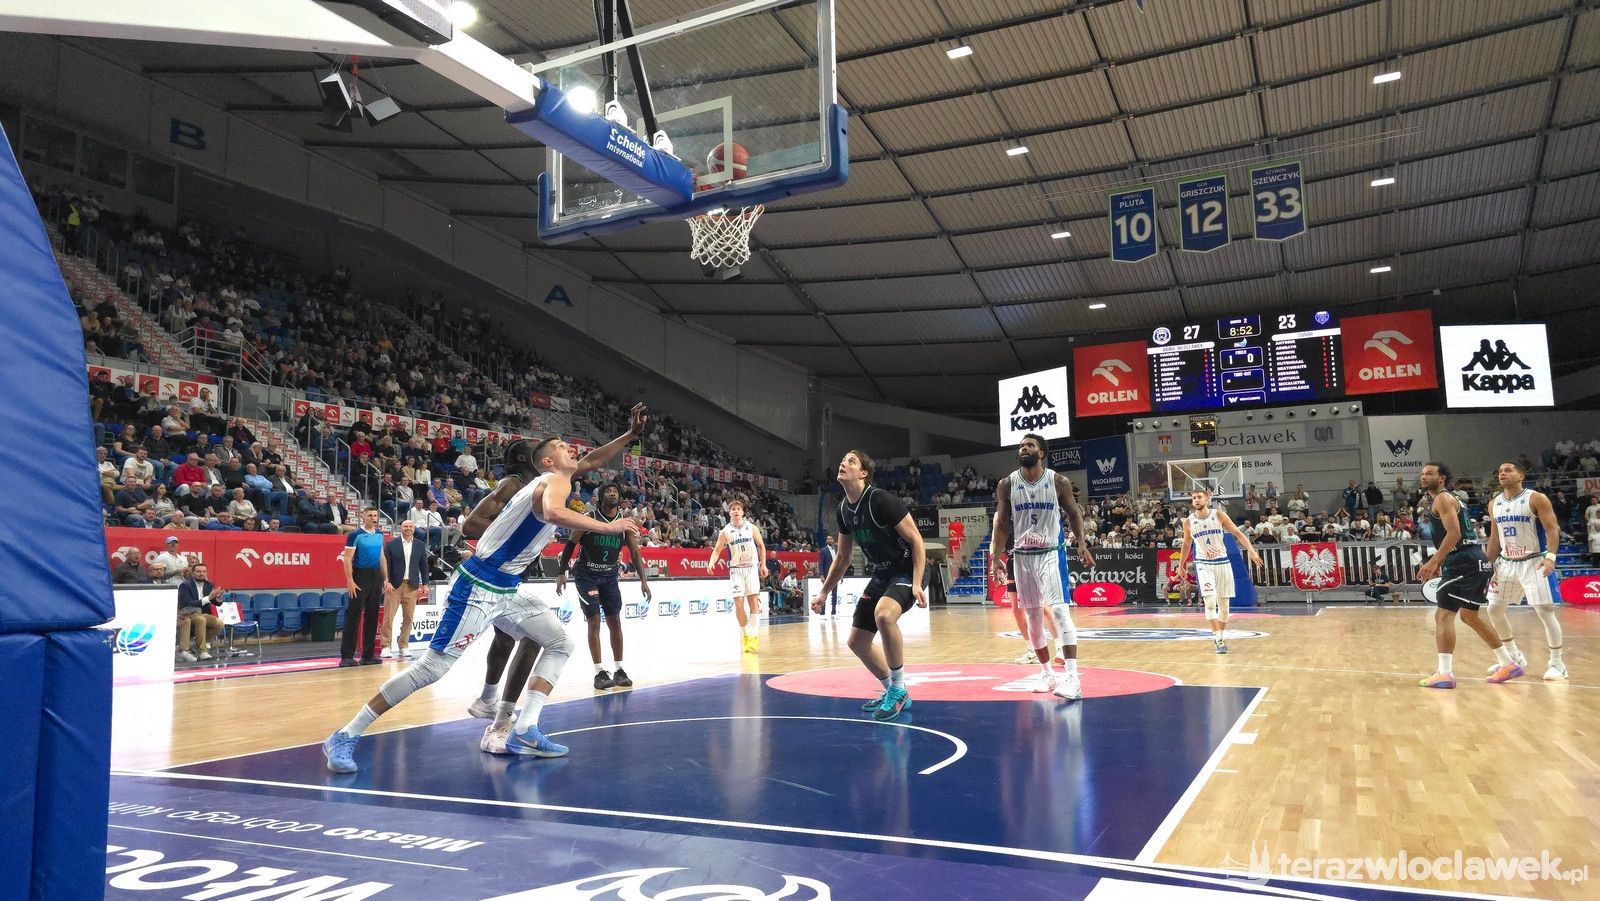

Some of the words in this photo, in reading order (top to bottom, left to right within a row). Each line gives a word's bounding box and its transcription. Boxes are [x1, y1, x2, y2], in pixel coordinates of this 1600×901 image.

[170, 118, 206, 150] B
[1253, 171, 1300, 185] SZEWCZYK
[1180, 184, 1225, 198] GRISZCZUK
[1119, 199, 1145, 208] PLUTA
[1256, 187, 1301, 222] 33
[1185, 200, 1223, 235] 12
[1114, 212, 1152, 245] 10
[543, 285, 574, 307] A
[1278, 314, 1296, 329] 23
[1183, 325, 1200, 340] 27
[1229, 325, 1253, 337] 8:52
[1228, 355, 1233, 364] 1
[1247, 353, 1254, 363] 0
[1358, 363, 1422, 381] ORLEN
[1461, 373, 1535, 393] Kappa
[1087, 389, 1138, 404] ORLEN
[1010, 411, 1058, 432] Kappa
[1215, 429, 1297, 447] ocławek
[1052, 450, 1081, 462] SELENKA
[1254, 459, 1273, 468] Bank
[1380, 460, 1423, 468] WŁOCŁAWEK
[1092, 477, 1123, 485] WŁOCŁAWEK
[1031, 514, 1038, 525] 5
[1503, 526, 1517, 538] 20
[263, 552, 310, 565] ORLEN
[602, 550, 609, 561] 2
[1068, 566, 1147, 584] ocławek
[166, 810, 325, 833] dobrego
[322, 827, 485, 853] Miasto
